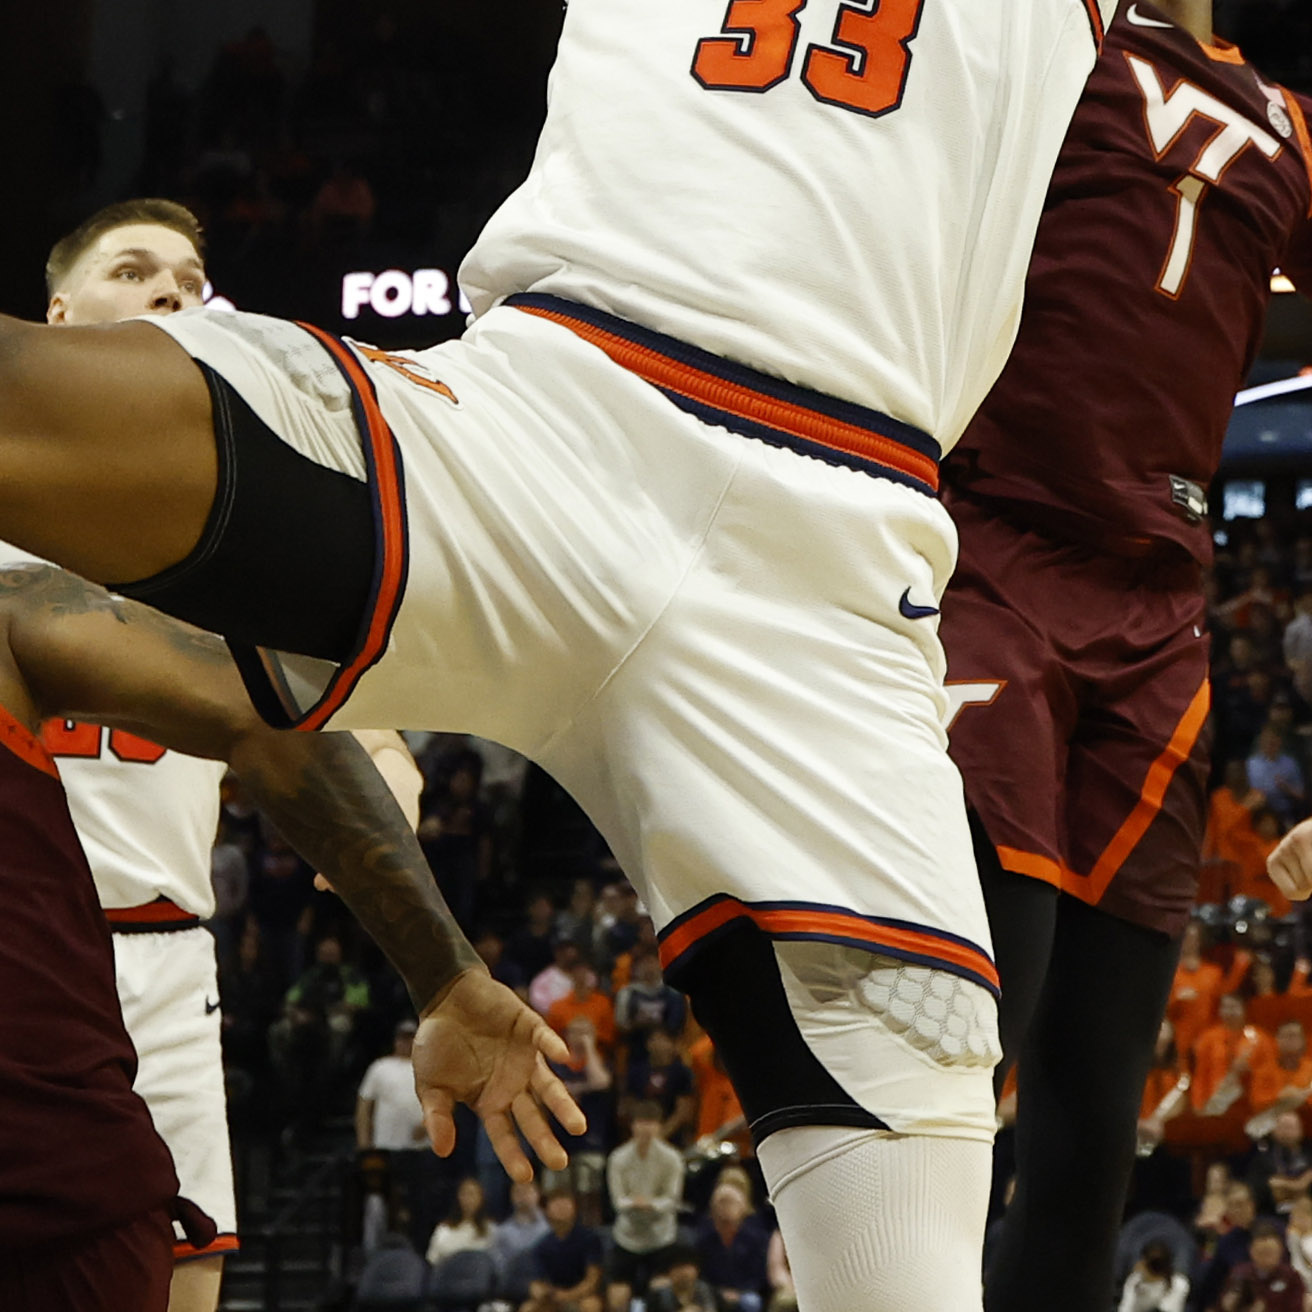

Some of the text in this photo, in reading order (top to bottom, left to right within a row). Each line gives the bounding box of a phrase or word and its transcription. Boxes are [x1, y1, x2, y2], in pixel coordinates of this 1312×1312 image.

[1122, 50, 1285, 185] VT
[341, 268, 452, 319] FOR
[1154, 174, 1207, 301] 1
